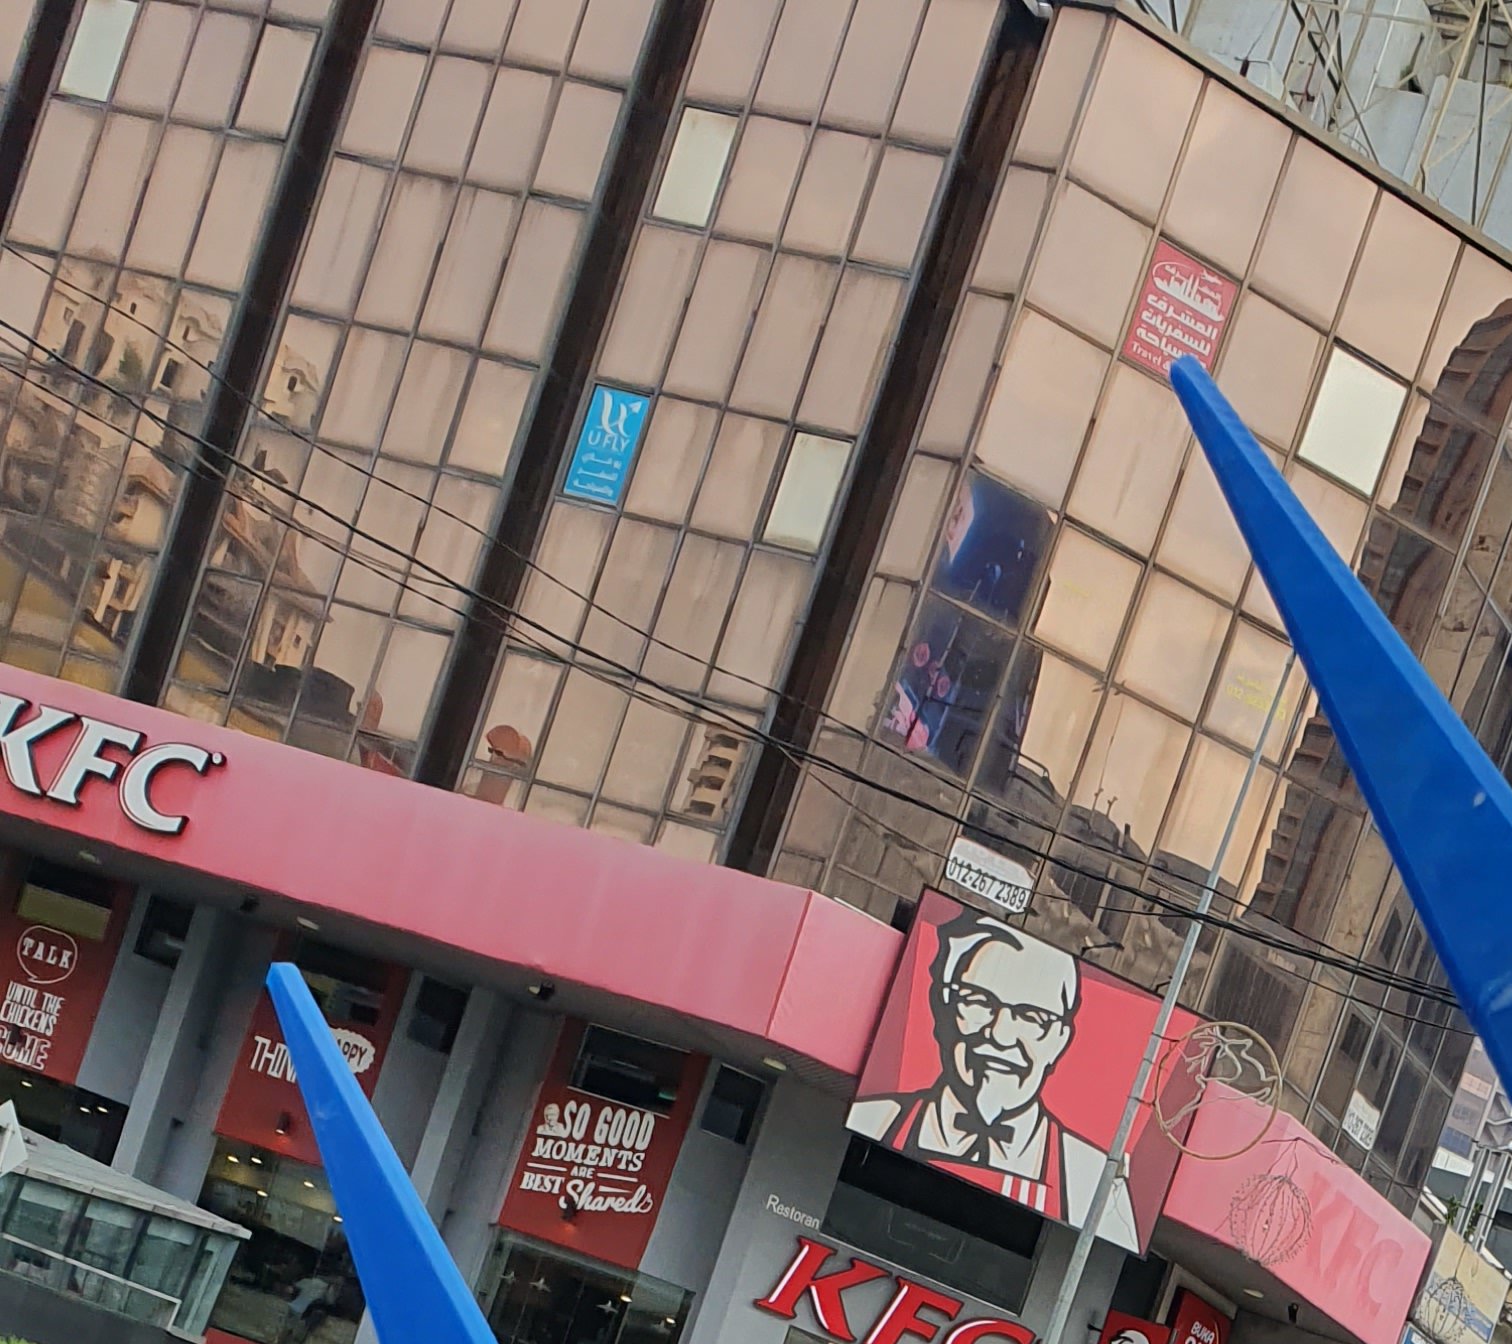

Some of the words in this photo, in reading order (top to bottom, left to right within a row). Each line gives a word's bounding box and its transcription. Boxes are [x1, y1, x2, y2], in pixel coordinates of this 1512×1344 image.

[0, 690, 210, 835] KFC
[995, 881, 1027, 910] 2389
[22, 936, 74, 969] TALK
[5, 980, 38, 1009] UNTIL
[42, 991, 66, 1017] THE
[0, 999, 58, 1037] CHICKENS
[250, 1035, 297, 1084] THIN
[560, 1100, 592, 1141] SO
[593, 1105, 656, 1151] GOOD
[531, 1137, 646, 1172] MOMENTS
[570, 1165, 596, 1179] ARE
[519, 1171, 566, 1195] BEST
[558, 1179, 654, 1213] Shared
[765, 1194, 821, 1231] Restoran
